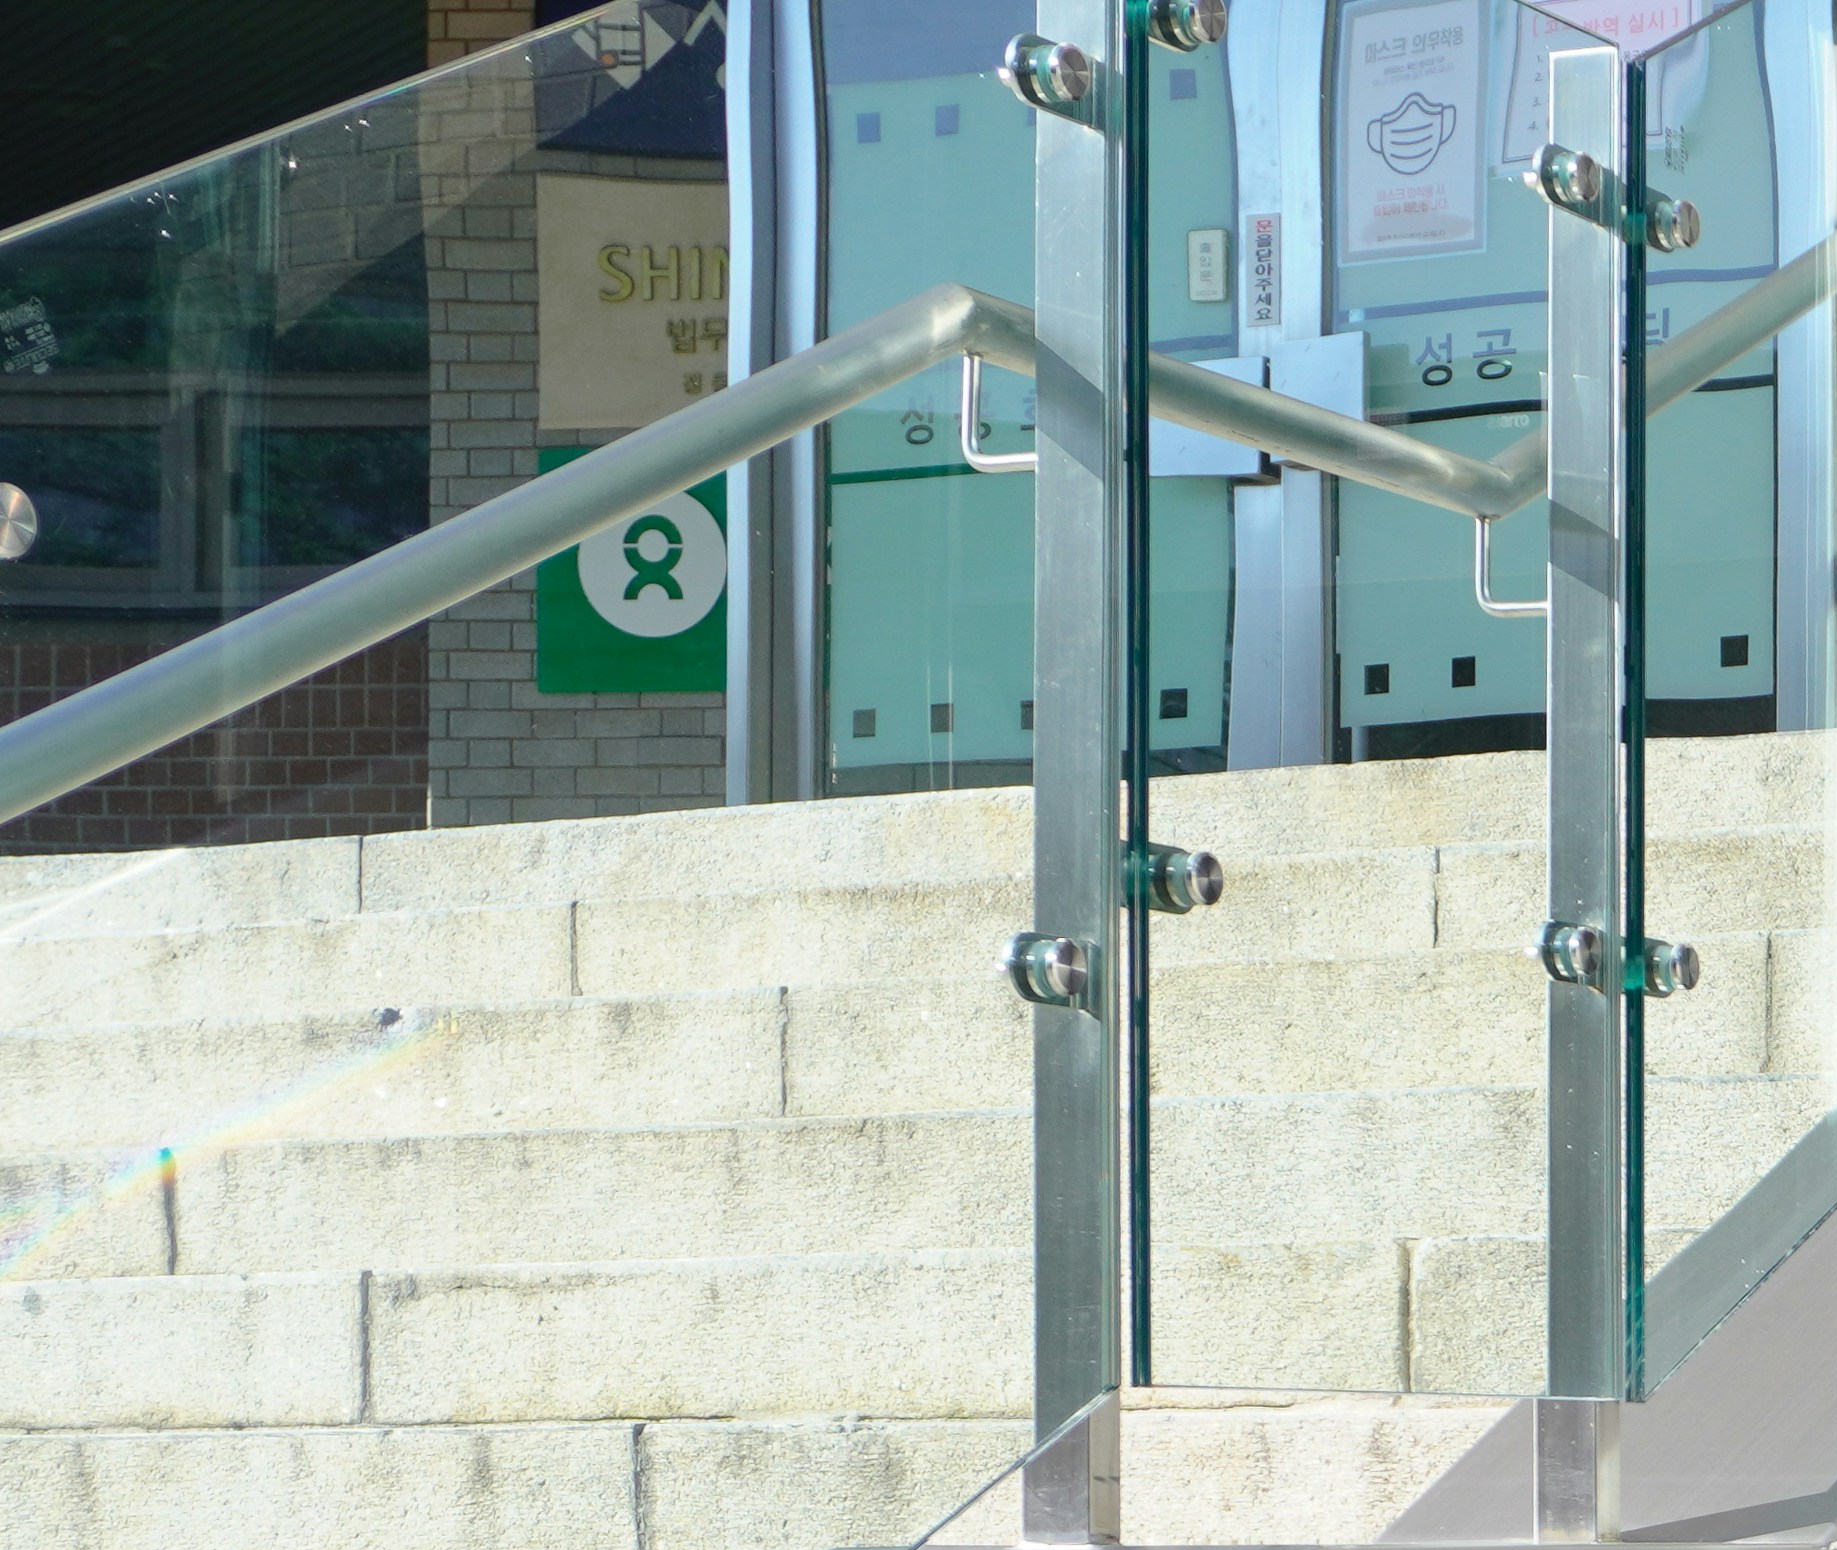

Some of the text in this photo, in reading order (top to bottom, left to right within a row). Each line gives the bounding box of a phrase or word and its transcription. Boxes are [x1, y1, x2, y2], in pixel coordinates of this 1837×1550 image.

[1629, 8, 1665, 34] 실시
[1365, 26, 1464, 63] 마스크 의무착용
[1255, 219, 1274, 321] 문을닫아주세요
